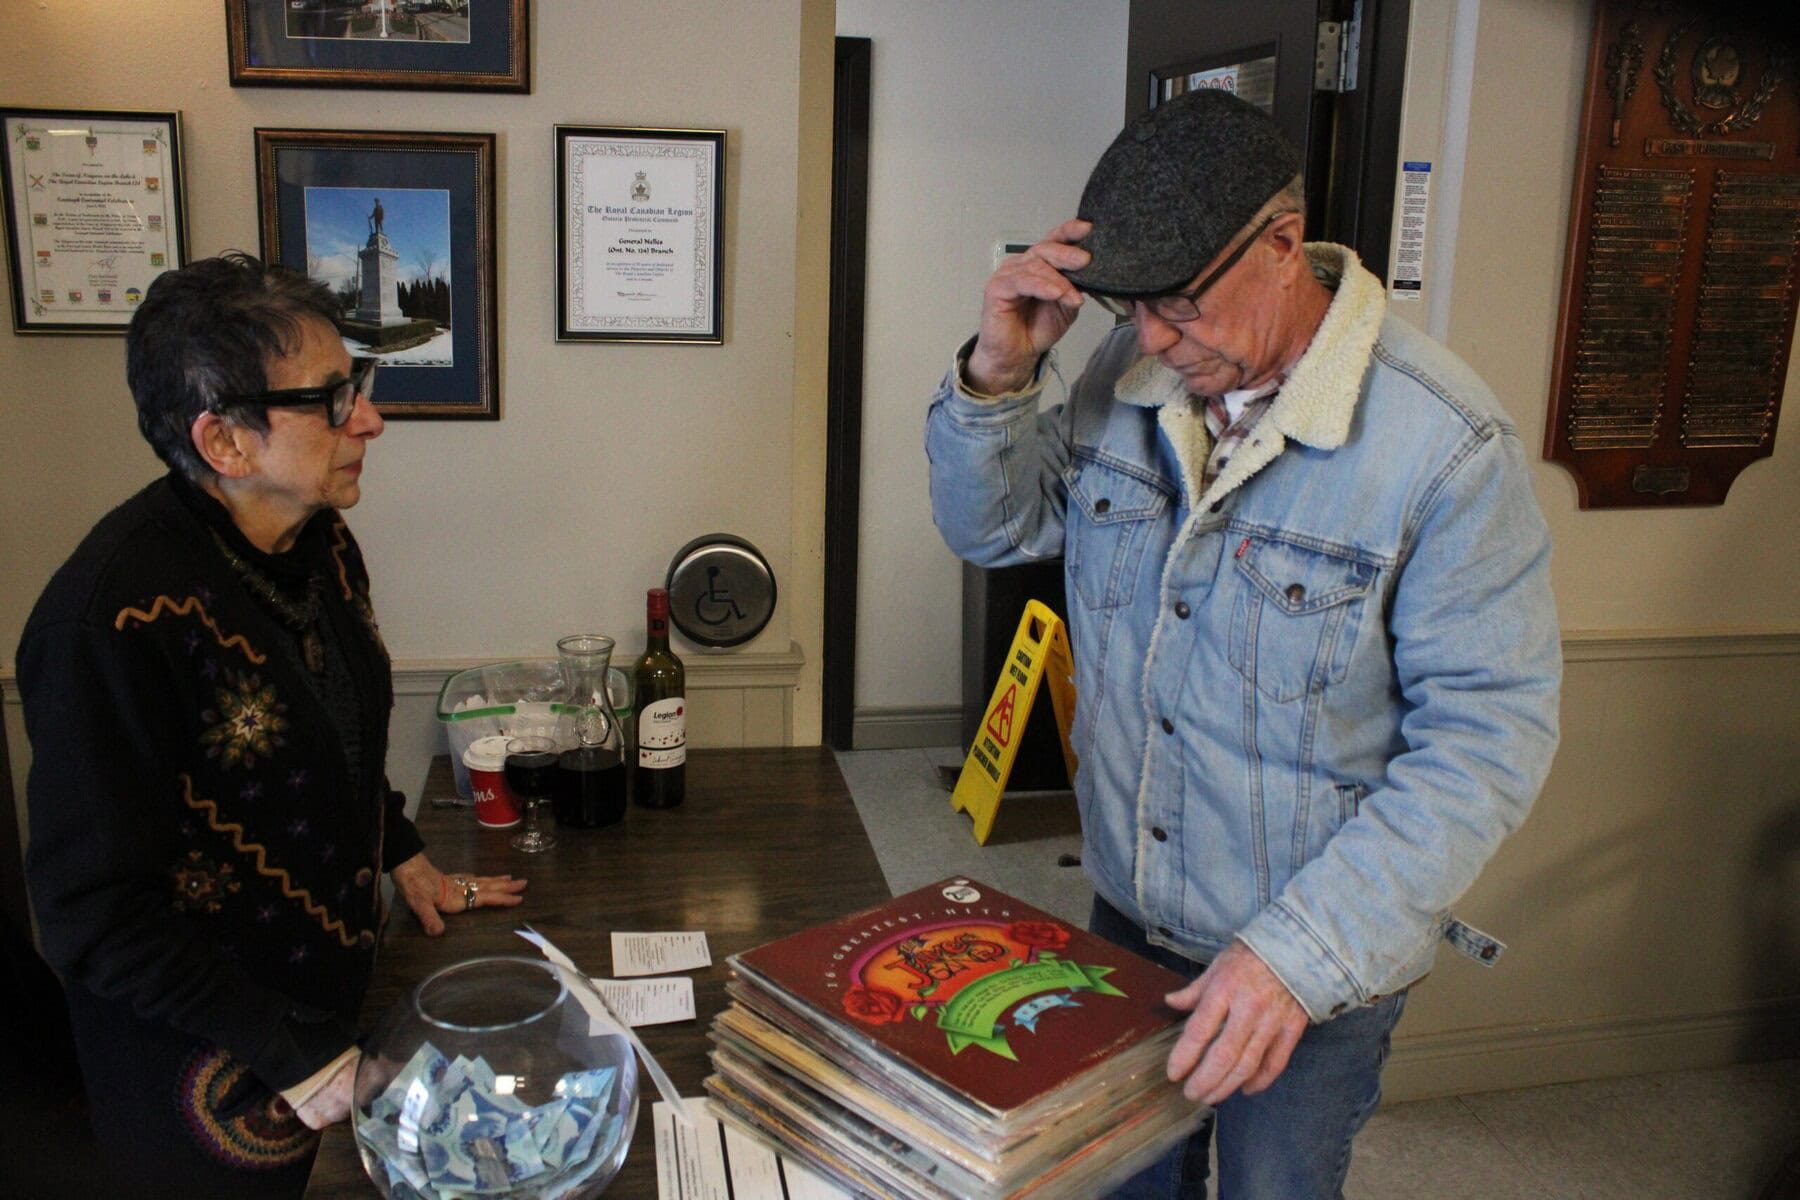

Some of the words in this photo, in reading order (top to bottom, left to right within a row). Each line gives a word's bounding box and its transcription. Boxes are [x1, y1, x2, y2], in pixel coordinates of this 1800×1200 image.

[587, 205, 602, 214] The
[605, 206, 627, 214] Royal
[630, 206, 664, 215] Canadian
[668, 207, 693, 216] Legion
[618, 237, 642, 245] General
[1016, 648, 1032, 669] CAUTION
[653, 711, 676, 720] Legion
[825, 971, 838, 988] 16
[833, 912, 922, 960] GREATEST
[945, 907, 1010, 918] HITS
